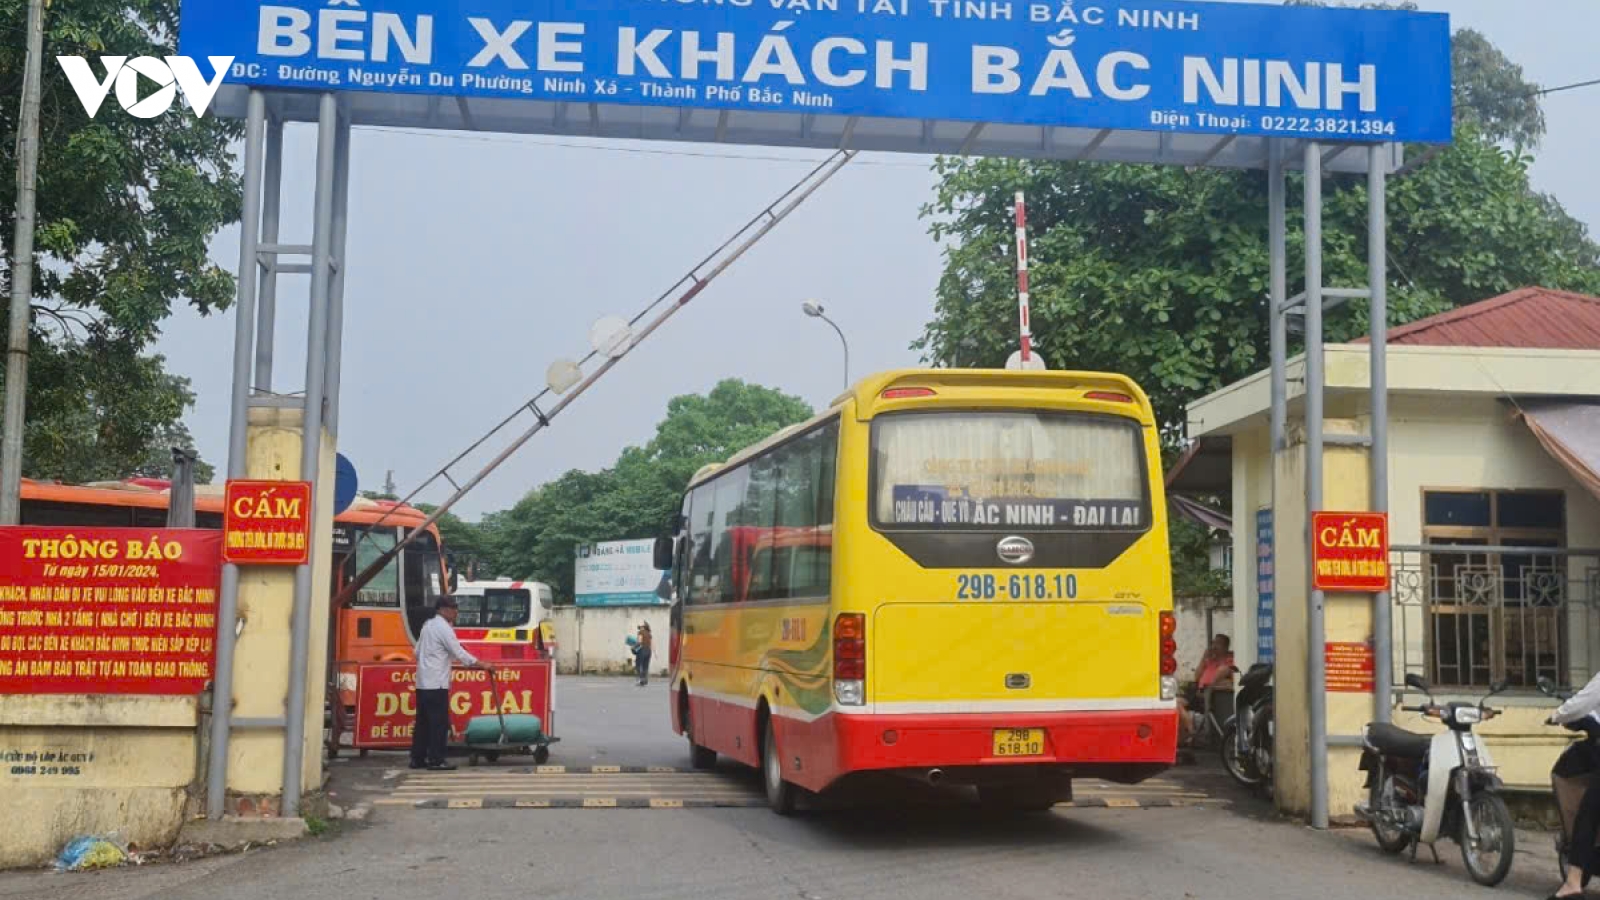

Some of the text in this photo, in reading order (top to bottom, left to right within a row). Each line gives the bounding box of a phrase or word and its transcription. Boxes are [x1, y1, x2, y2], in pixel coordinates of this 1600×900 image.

[1118, 8, 1199, 30] NINH
[466, 17, 585, 72] XE
[617, 20, 928, 91] KHÁCH
[971, 29, 1150, 100] BẮC
[1183, 56, 1376, 112] NINH
[231, 62, 267, 78] ĐC:
[277, 64, 340, 84] Đường
[348, 68, 421, 86] Nguyễn
[429, 72, 453, 87] Du
[461, 73, 534, 93] Phường
[544, 77, 585, 93] Ninh
[640, 81, 696, 99] Thành
[706, 85, 742, 101] Phố
[748, 86, 783, 104] Bắc
[793, 91, 833, 107] Ninh
[1150, 110, 1189, 130] Điện
[1261, 115, 1396, 135] 0222.3821.394
[233, 487, 301, 519] CẤM
[1005, 504, 1054, 525] NINH
[1320, 517, 1381, 548] CẤM
[23, 533, 183, 560] THÔNG BÁO
[167, 588, 176, 603] XE
[957, 574, 1077, 599] 29B-618.10
[163, 612, 174, 627] XE
[60, 636, 69, 651] XE
